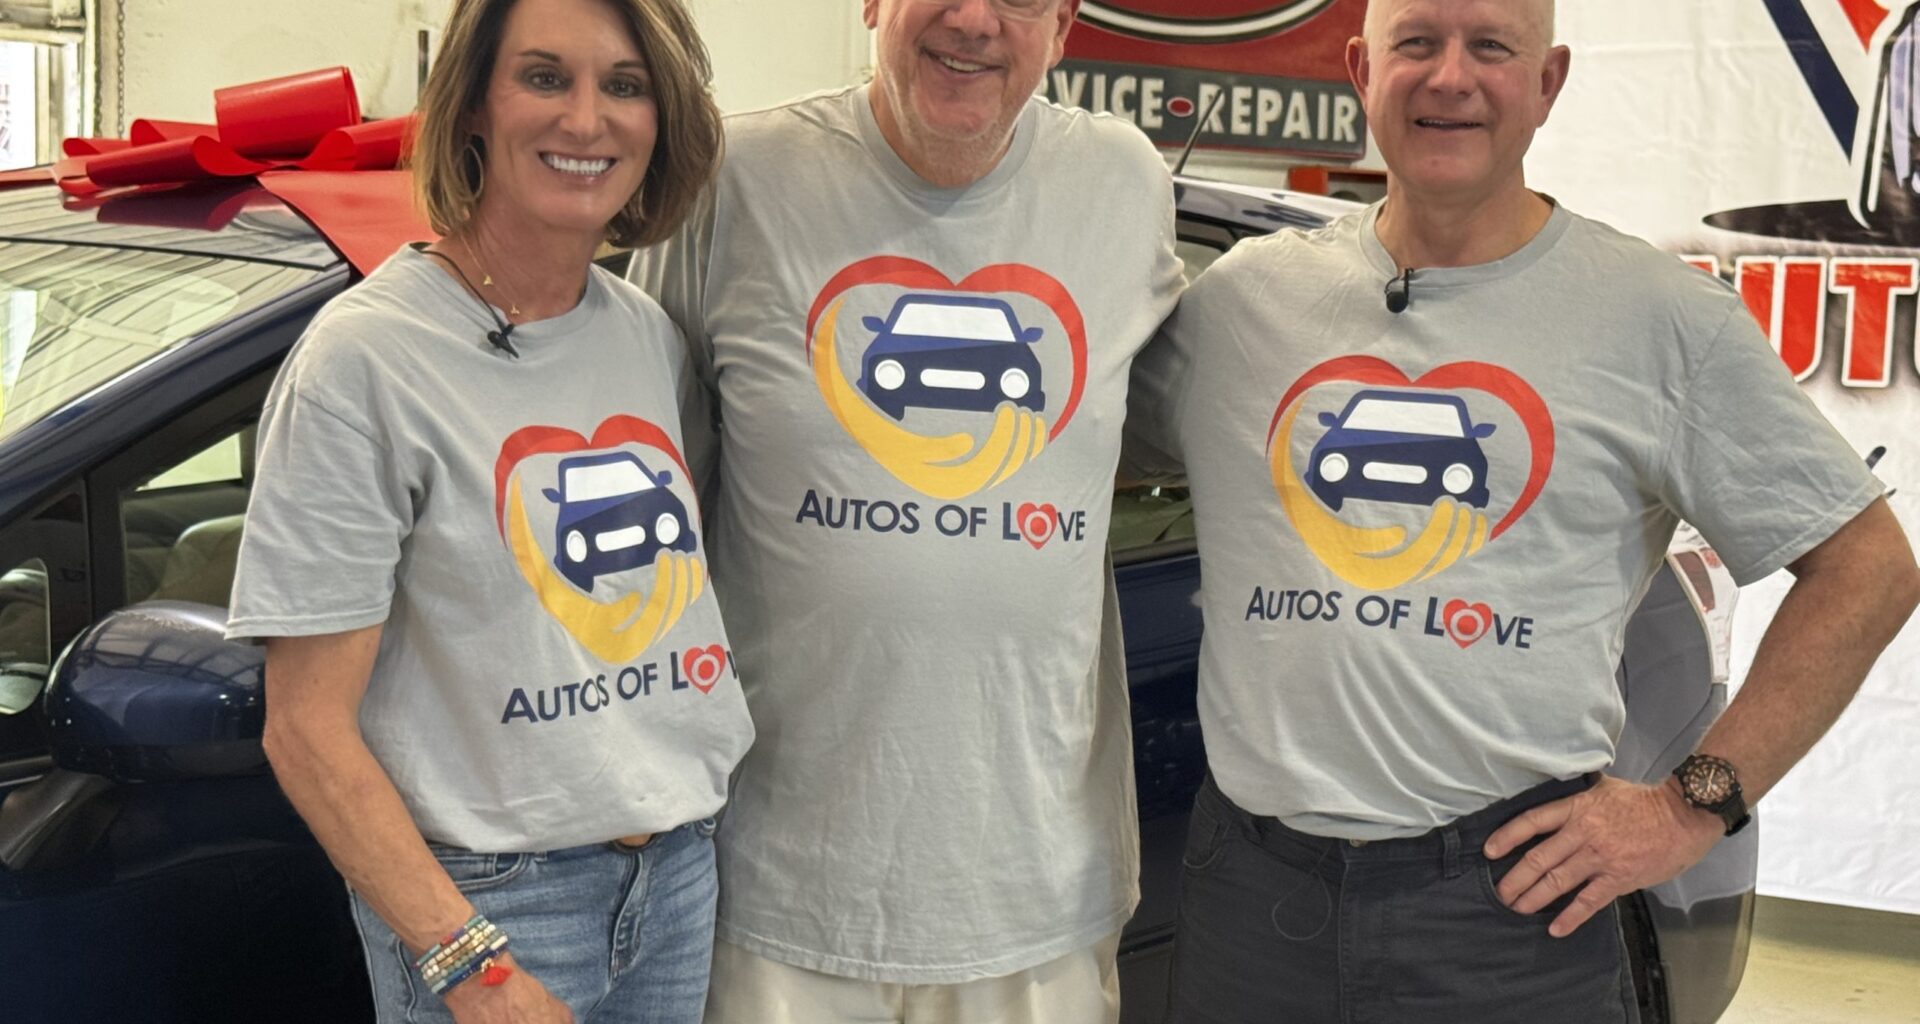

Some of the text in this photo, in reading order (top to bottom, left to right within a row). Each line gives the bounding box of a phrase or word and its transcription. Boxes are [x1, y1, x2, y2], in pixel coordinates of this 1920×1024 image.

[1034, 70, 1358, 143] VICE REPAIR
[795, 489, 1086, 550] AUTOS OF LOVE
[1245, 586, 1534, 649] AUTOS OF LOVE
[501, 674, 610, 724] AUTOS
[617, 662, 658, 701] OF
